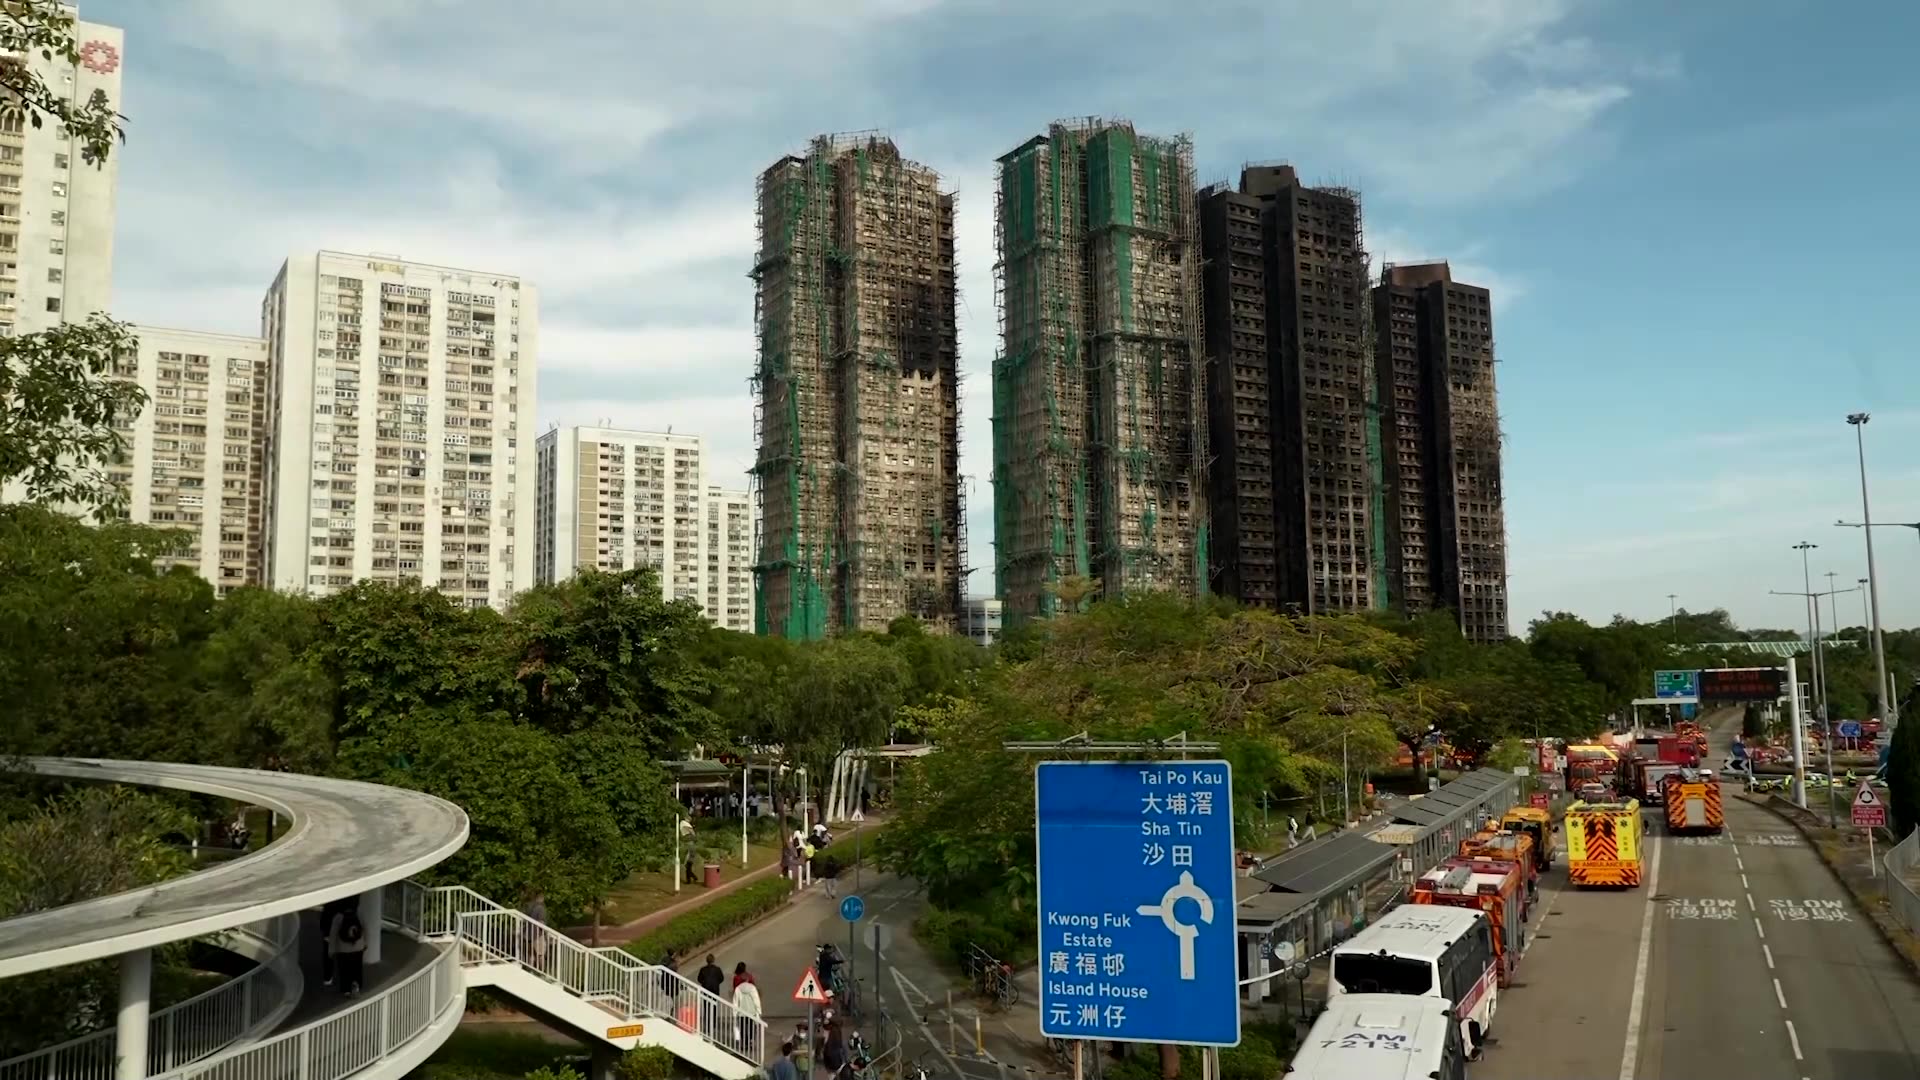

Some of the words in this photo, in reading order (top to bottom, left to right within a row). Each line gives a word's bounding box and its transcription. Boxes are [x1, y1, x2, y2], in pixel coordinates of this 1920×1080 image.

[1139, 770, 1162, 785] Tai
[1167, 770, 1187, 785] Po
[1192, 770, 1222, 785] Kau
[1141, 791, 1213, 816] 大埔滘
[1141, 821, 1171, 836] Sha
[1177, 821, 1202, 836] Tin
[1142, 842, 1193, 867] 沙田
[1665, 898, 1737, 907] SLOW
[1768, 899, 1844, 908] SLOW
[1048, 911, 1099, 930] Kwong
[1103, 912, 1132, 928] Fuk
[1063, 932, 1113, 948] Estate
[1048, 951, 1125, 977] 廣福邨
[1049, 980, 1094, 997] Island
[1099, 982, 1149, 999] House
[1049, 1002, 1127, 1029] 元洲仔
[1319, 1040, 1401, 1050] 7213
[1342, 1033, 1407, 1042] AM
